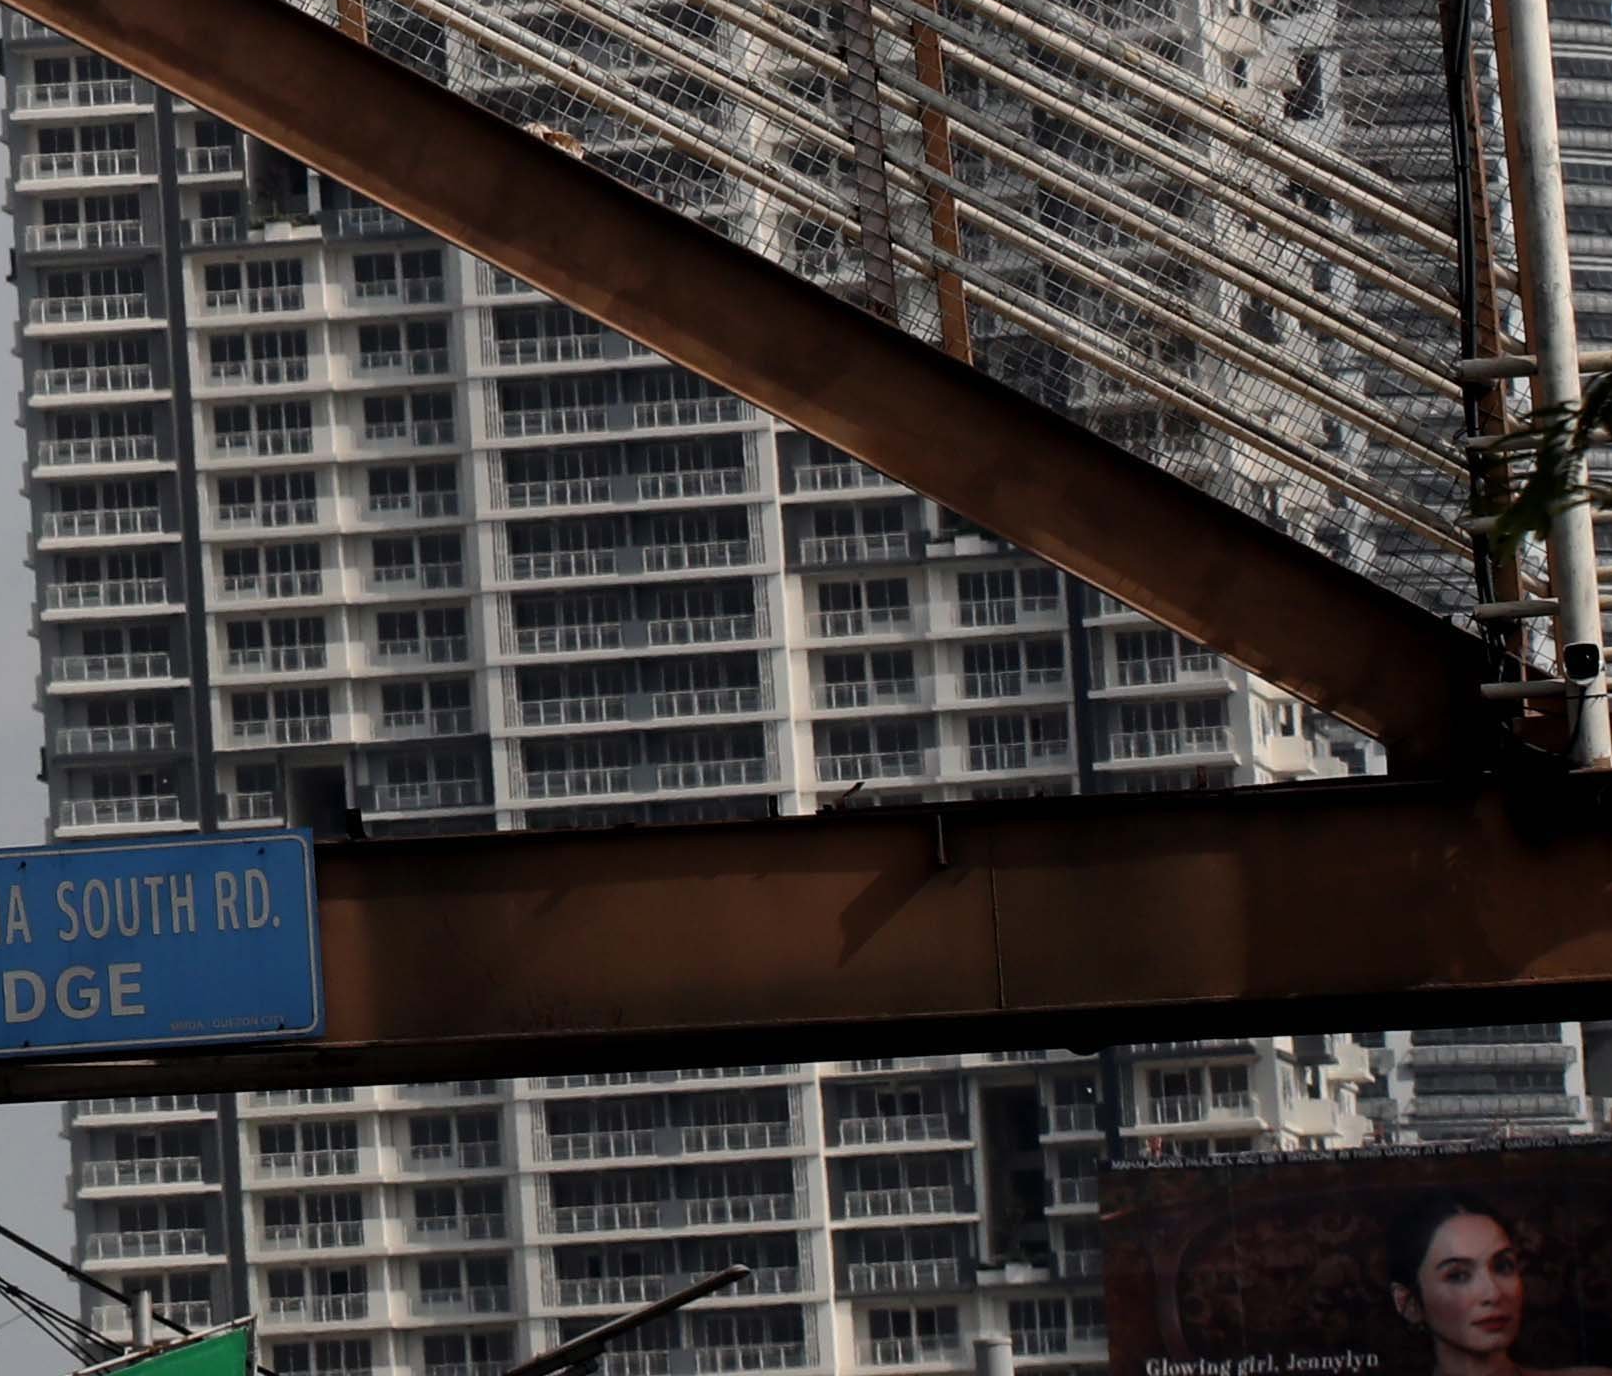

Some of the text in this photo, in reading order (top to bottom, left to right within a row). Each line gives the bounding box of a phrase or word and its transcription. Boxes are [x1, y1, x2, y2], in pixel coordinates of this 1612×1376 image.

[57, 873, 196, 941] SOUTH
[215, 868, 281, 931] RD.
[1145, 1357, 1233, 1376] Glowing
[1287, 1349, 1379, 1373] Jennylyn
